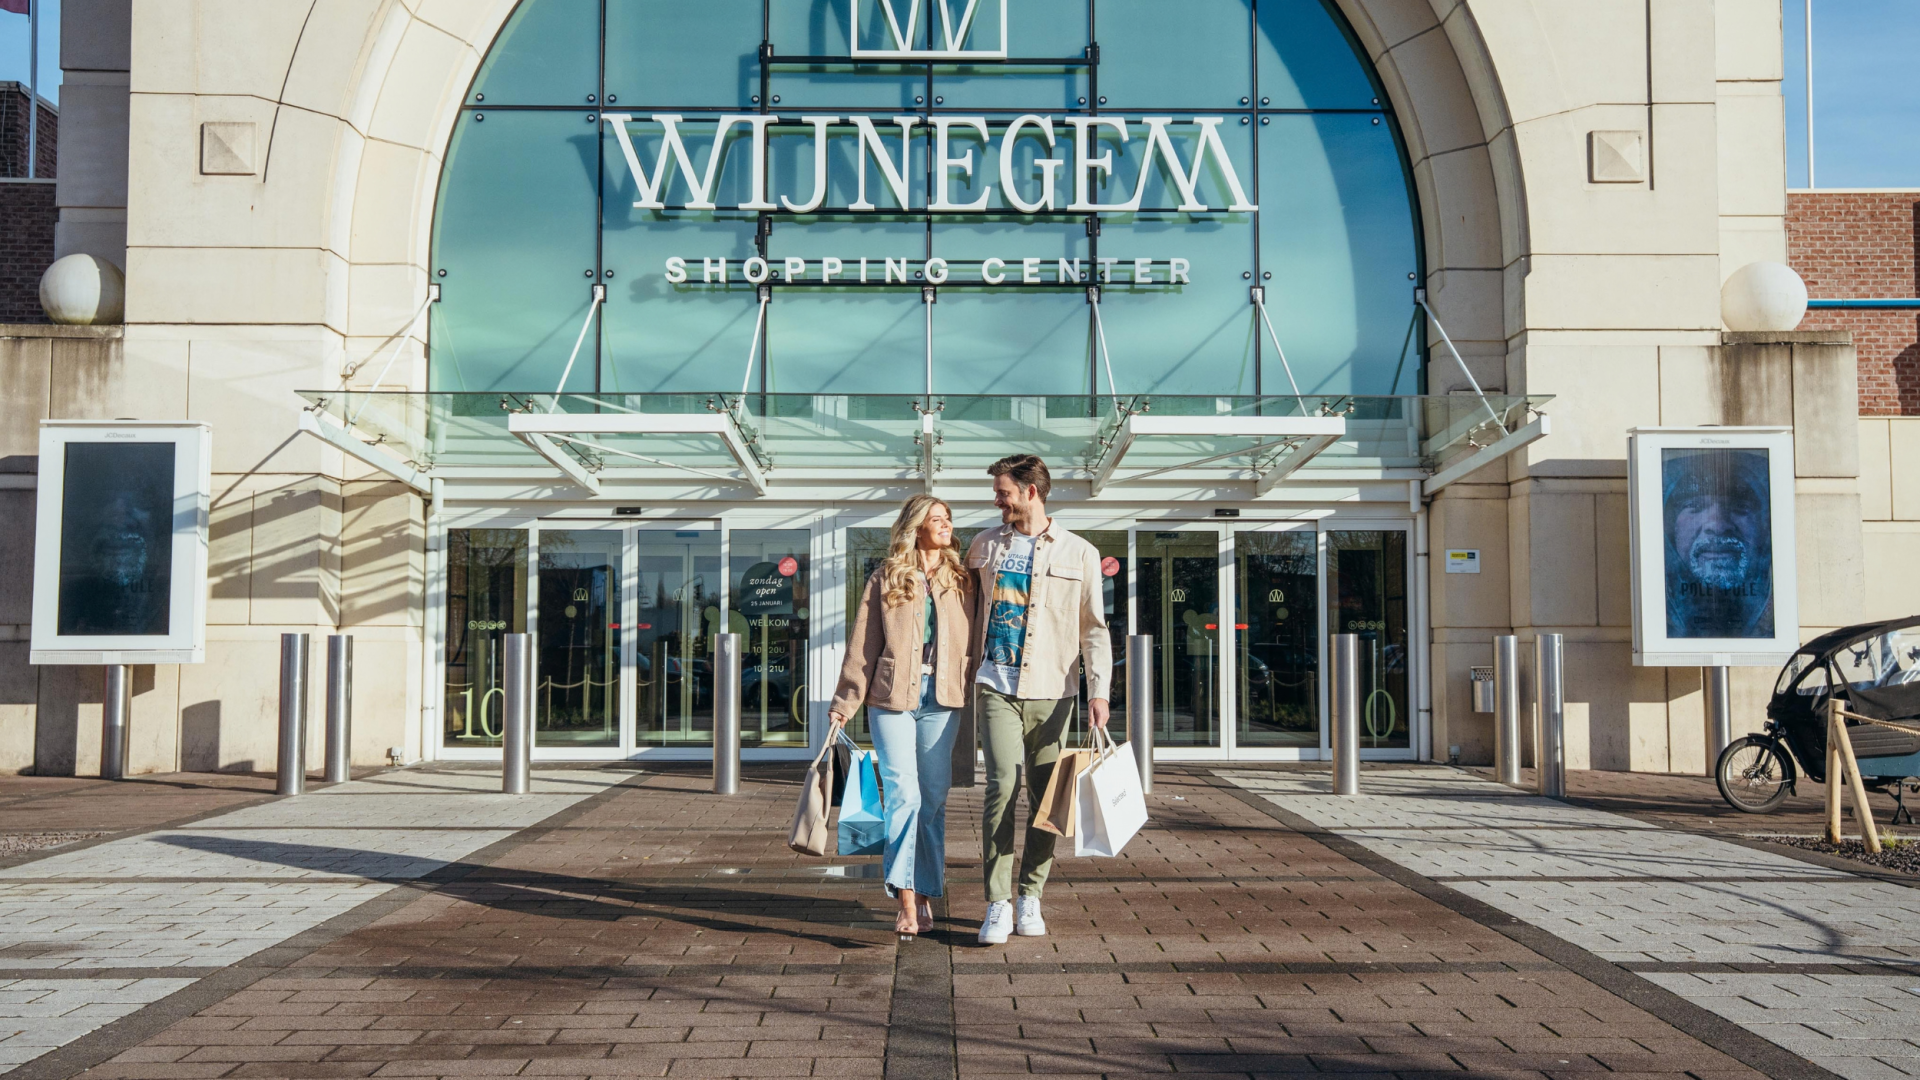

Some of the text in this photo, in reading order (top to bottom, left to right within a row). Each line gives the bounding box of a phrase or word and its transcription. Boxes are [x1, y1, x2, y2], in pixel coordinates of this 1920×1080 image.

[602, 113, 1258, 214] WIJNEGEM
[664, 256, 1191, 284] SHOPPING CENTER
[749, 575, 783, 588] zondag
[755, 588, 777, 598] open
[1681, 582, 1713, 597] POLE
[750, 619, 790, 627] WELKOM
[753, 646, 785, 654] 10 20U
[769, 665, 785, 673] 21U
[456, 687, 504, 738] 10
